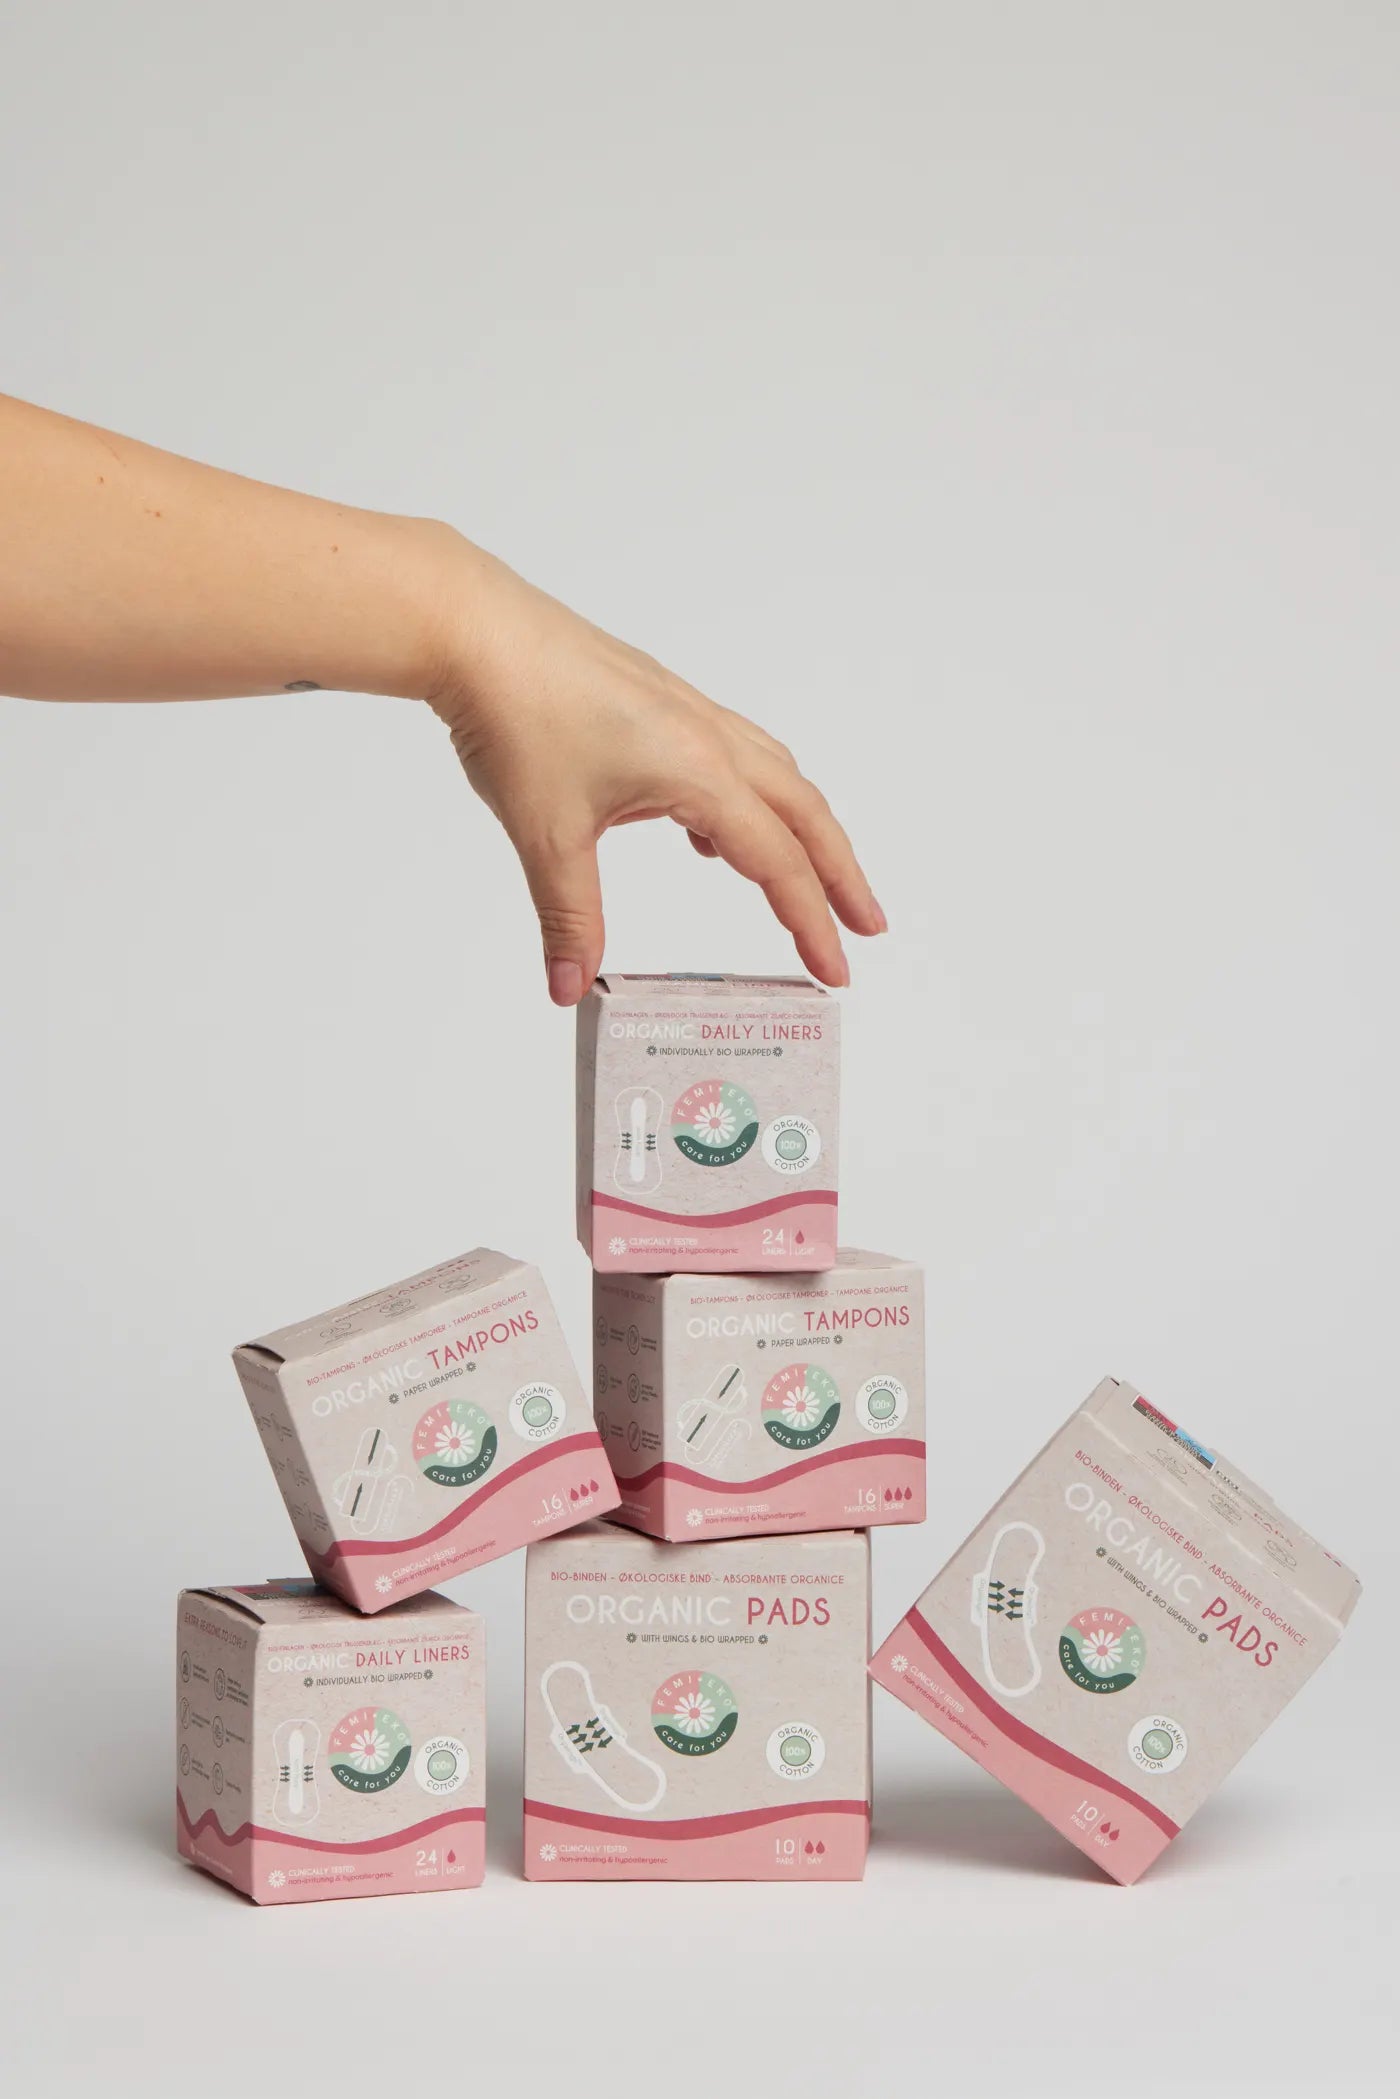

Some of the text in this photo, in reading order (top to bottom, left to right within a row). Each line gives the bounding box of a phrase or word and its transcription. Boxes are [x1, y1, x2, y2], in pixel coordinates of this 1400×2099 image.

[610, 1023, 822, 1040] ORGANIC DAILY LINERS
[659, 1048, 772, 1057] INDIVIDUALLY BIO WRAPPED
[773, 1120, 814, 1136] ORGANIC
[681, 1141, 748, 1163] care for you
[774, 1155, 810, 1171] COTTON
[762, 1229, 784, 1244] 24
[690, 1295, 738, 1304] BIO-TAMPONS
[836, 1288, 872, 1296] TAMPOANE
[874, 1286, 909, 1294] ORGANICE
[686, 1305, 910, 1339] ORGANIC TAMPONS
[306, 1360, 356, 1386] BIO-TAMPONS
[453, 1308, 491, 1326] TAMPOANE
[492, 1290, 528, 1311] ORGANICE
[771, 1336, 830, 1348] PAPER WRAPPED
[311, 1358, 424, 1417] ORGANIC
[427, 1310, 539, 1370] TAMPONS
[403, 1368, 464, 1398] PAPER WRAPPED
[865, 1380, 902, 1394] ORGANIC
[515, 1387, 554, 1406] ORGANIC
[528, 1416, 560, 1438] COTTON
[867, 1414, 900, 1430] COTTON
[771, 1422, 831, 1446] care for you
[432, 1448, 492, 1483] care for you
[542, 1494, 562, 1514] 16
[858, 1488, 876, 1505] 16
[1074, 1450, 1123, 1493] BIO-BINDEN
[1128, 1495, 1185, 1545] ØKOLOGISKE
[1183, 1540, 1203, 1560] BIND
[1208, 1563, 1263, 1610] ABSORBANTE
[1262, 1607, 1308, 1647] ORGANICE
[551, 1572, 845, 1585] BIO-BINDEN ØKOLOGISKE BIND ABSORBANTE ORGANICE
[1065, 1482, 1279, 1667] ORGANIC PADS
[1107, 1556, 1198, 1635] WITH WINGS & BIO WRAPPED
[566, 1595, 831, 1626] ORGANIC PADS
[641, 1635, 755, 1644] WITH WINGS & BIO WRAPPED
[267, 1645, 470, 1673] ORGANIC DAILY LINERS
[1063, 1644, 1115, 1691] care for you
[316, 1672, 423, 1686] INDIVIDUALLY BIO WRAPPED
[662, 1730, 728, 1752] care for you
[778, 1726, 819, 1742] ORGANIC
[1153, 1719, 1184, 1750] ORGANIC
[424, 1740, 464, 1755] ORGANIC
[1133, 1745, 1164, 1770] COTTON
[338, 1766, 401, 1789] care for you
[779, 1761, 815, 1777] COTTON
[426, 1775, 460, 1791] COTTON
[1077, 1800, 1098, 1821] 10
[775, 1839, 796, 1855] 10
[416, 1850, 438, 1866] 24
